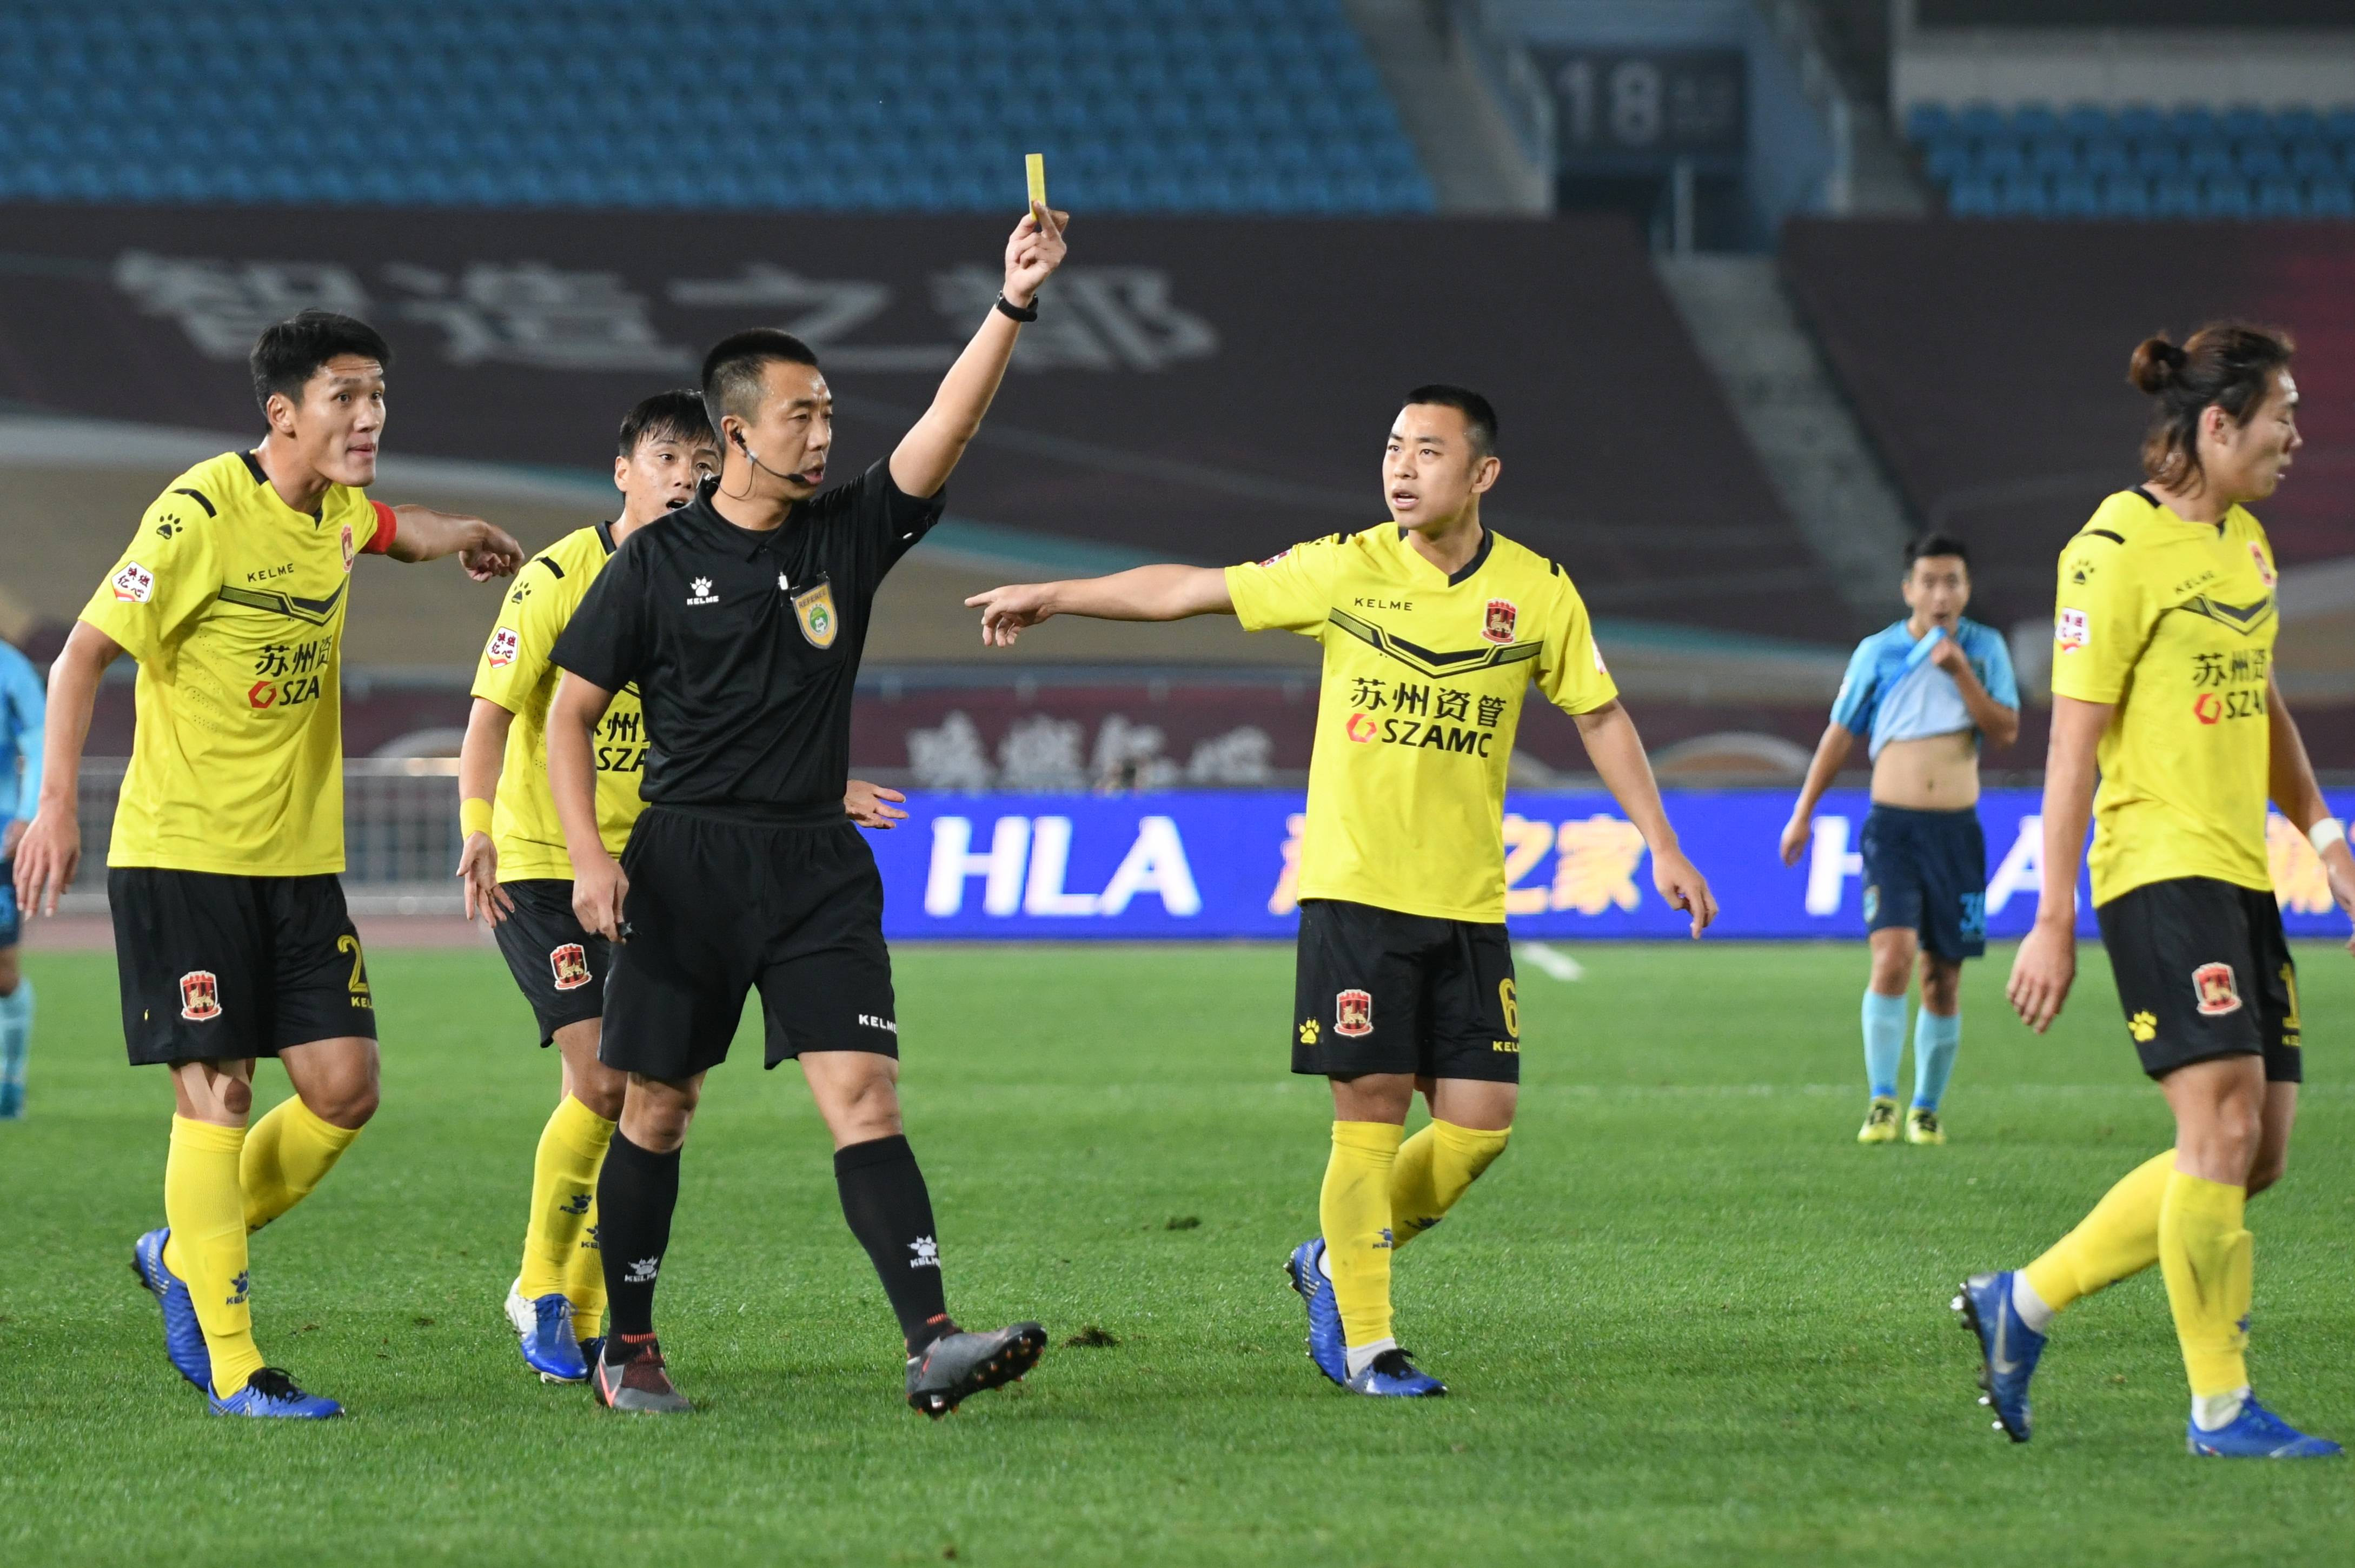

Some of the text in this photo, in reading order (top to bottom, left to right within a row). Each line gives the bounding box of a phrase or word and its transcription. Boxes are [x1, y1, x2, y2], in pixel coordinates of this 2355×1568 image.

[1558, 59, 1662, 145] 18
[247, 563, 294, 583] KELME
[686, 595, 719, 606] KELME
[798, 588, 826, 609] REFEREE
[1355, 597, 1413, 612] KELME
[279, 676, 320, 706] SZA
[1350, 677, 1507, 728] 苏州资管
[1381, 718, 1493, 758] SZAMC
[925, 814, 1203, 918] HLA
[337, 934, 369, 992] 2
[1499, 978, 1519, 1038] 6
[1493, 1040, 1519, 1052] KEL
